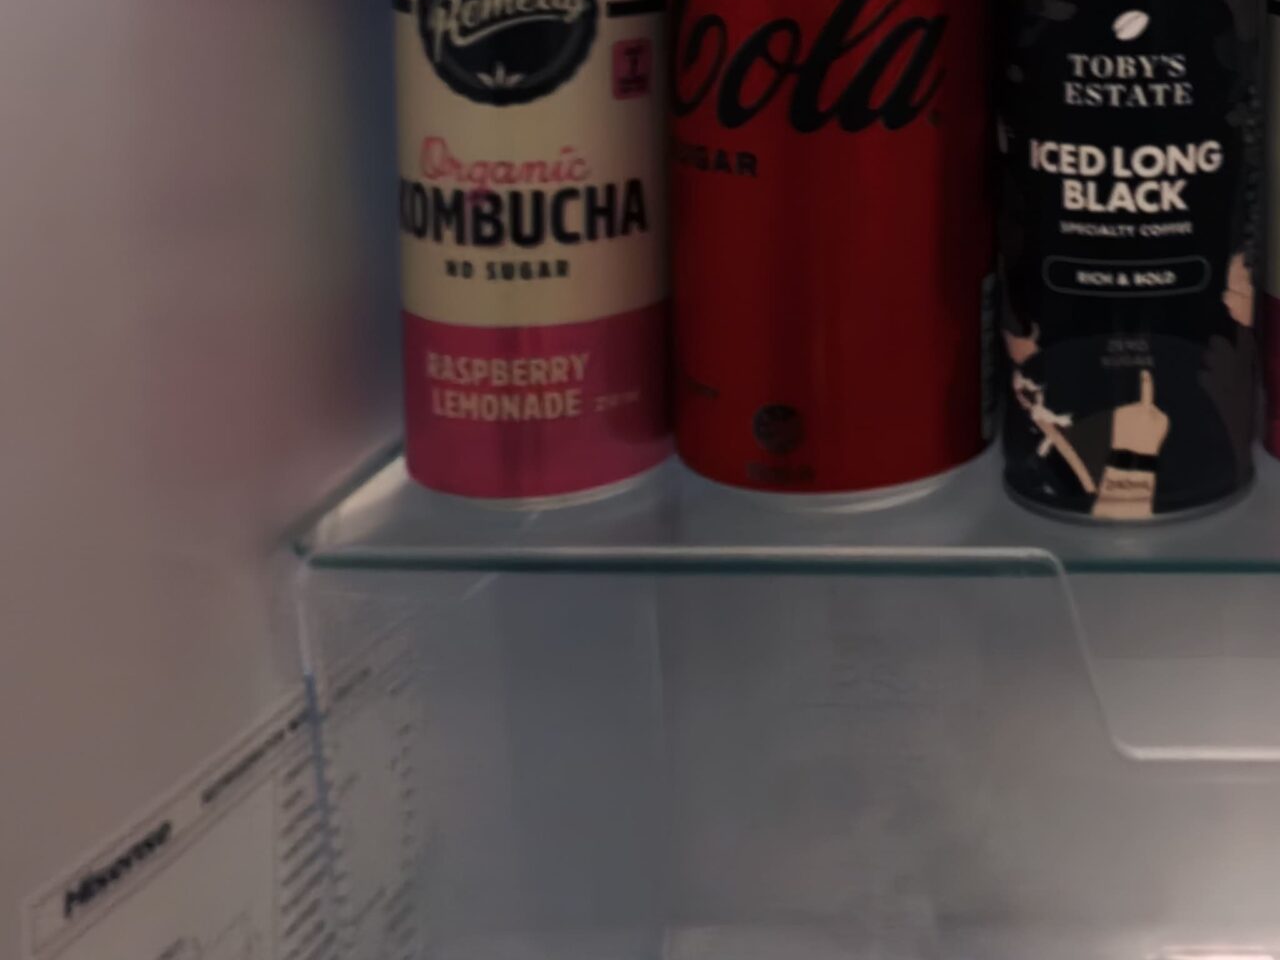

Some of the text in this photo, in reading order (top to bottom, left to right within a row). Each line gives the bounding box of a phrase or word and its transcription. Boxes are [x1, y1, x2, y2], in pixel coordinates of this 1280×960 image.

[1066, 53, 1187, 80] TOBY'S
[1063, 81, 1194, 108] ESTATE
[421, 136, 589, 203] Organic
[676, 141, 759, 179] GAR
[1029, 140, 1224, 179] ICED LONG
[1061, 178, 1189, 214] BLACK
[445, 259, 570, 281] NO SUGAR
[426, 352, 590, 387] RASPBERRY
[431, 390, 584, 423] LEMONADE
